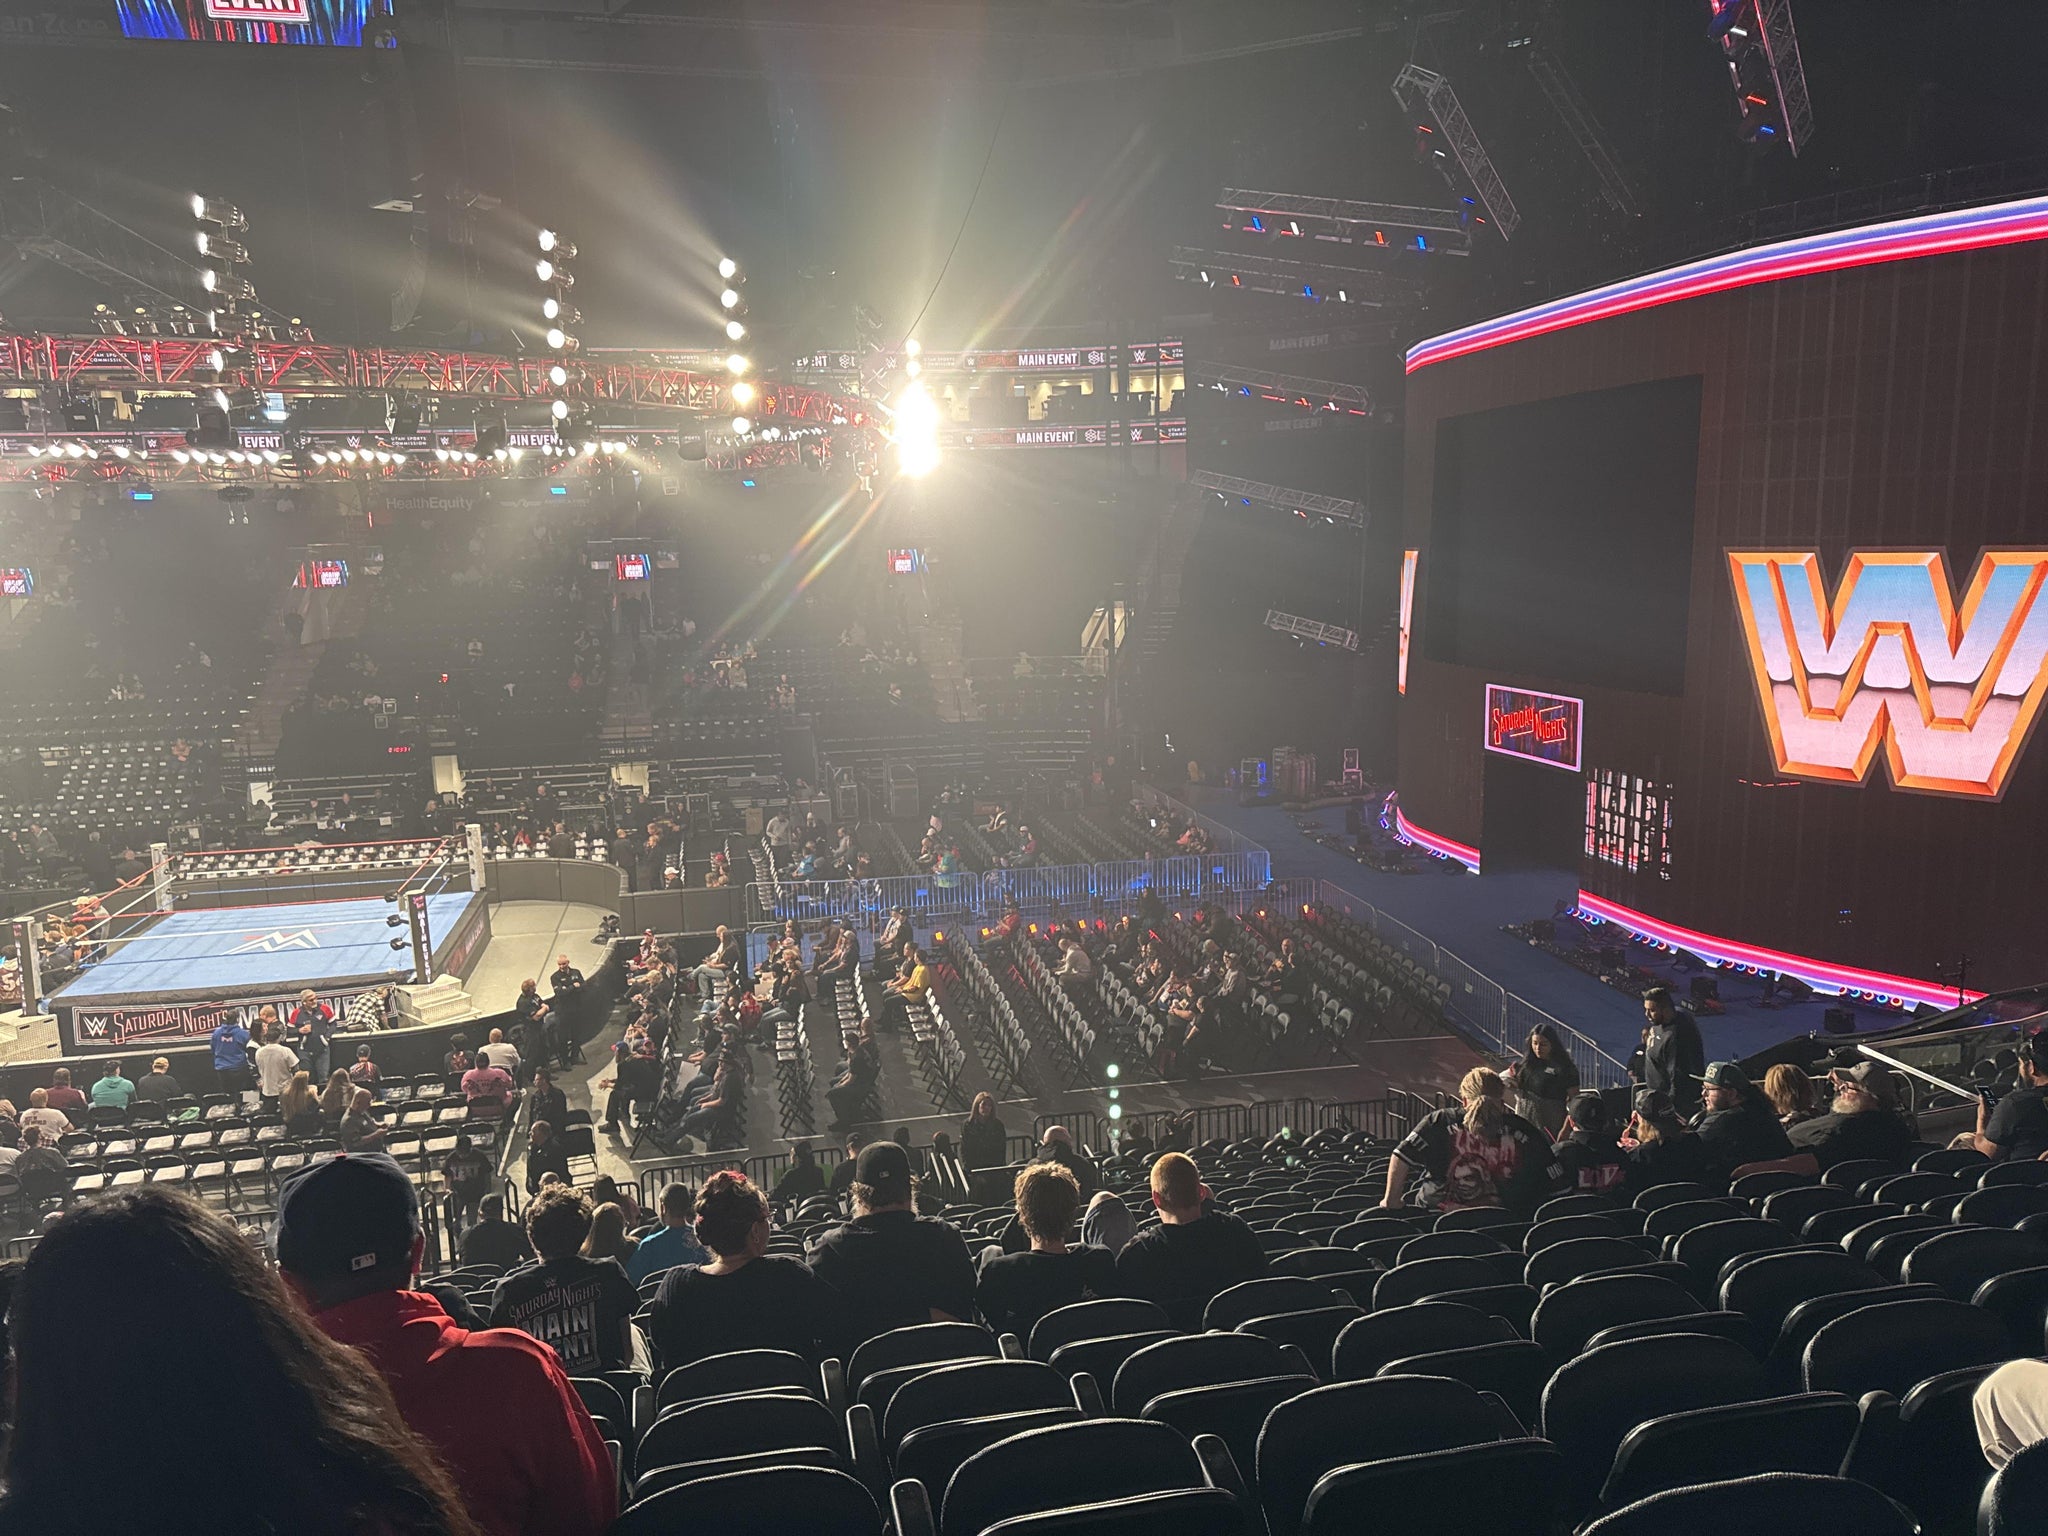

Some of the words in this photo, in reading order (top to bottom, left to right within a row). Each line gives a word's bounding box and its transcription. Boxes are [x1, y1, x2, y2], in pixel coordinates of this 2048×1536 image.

[1019, 354, 1045, 366] MAIN
[1047, 353, 1077, 365] EVENT
[244, 437, 280, 448] EVENT
[1016, 432, 1043, 444] MAIN
[1044, 431, 1074, 443] EVENT
[386, 497, 474, 511] HealthEquity
[1493, 706, 1535, 745] SATURDAY
[112, 1008, 181, 1045] SATURDAY
[509, 1287, 560, 1326] SATURDAY
[522, 1305, 589, 1341] MAIN
